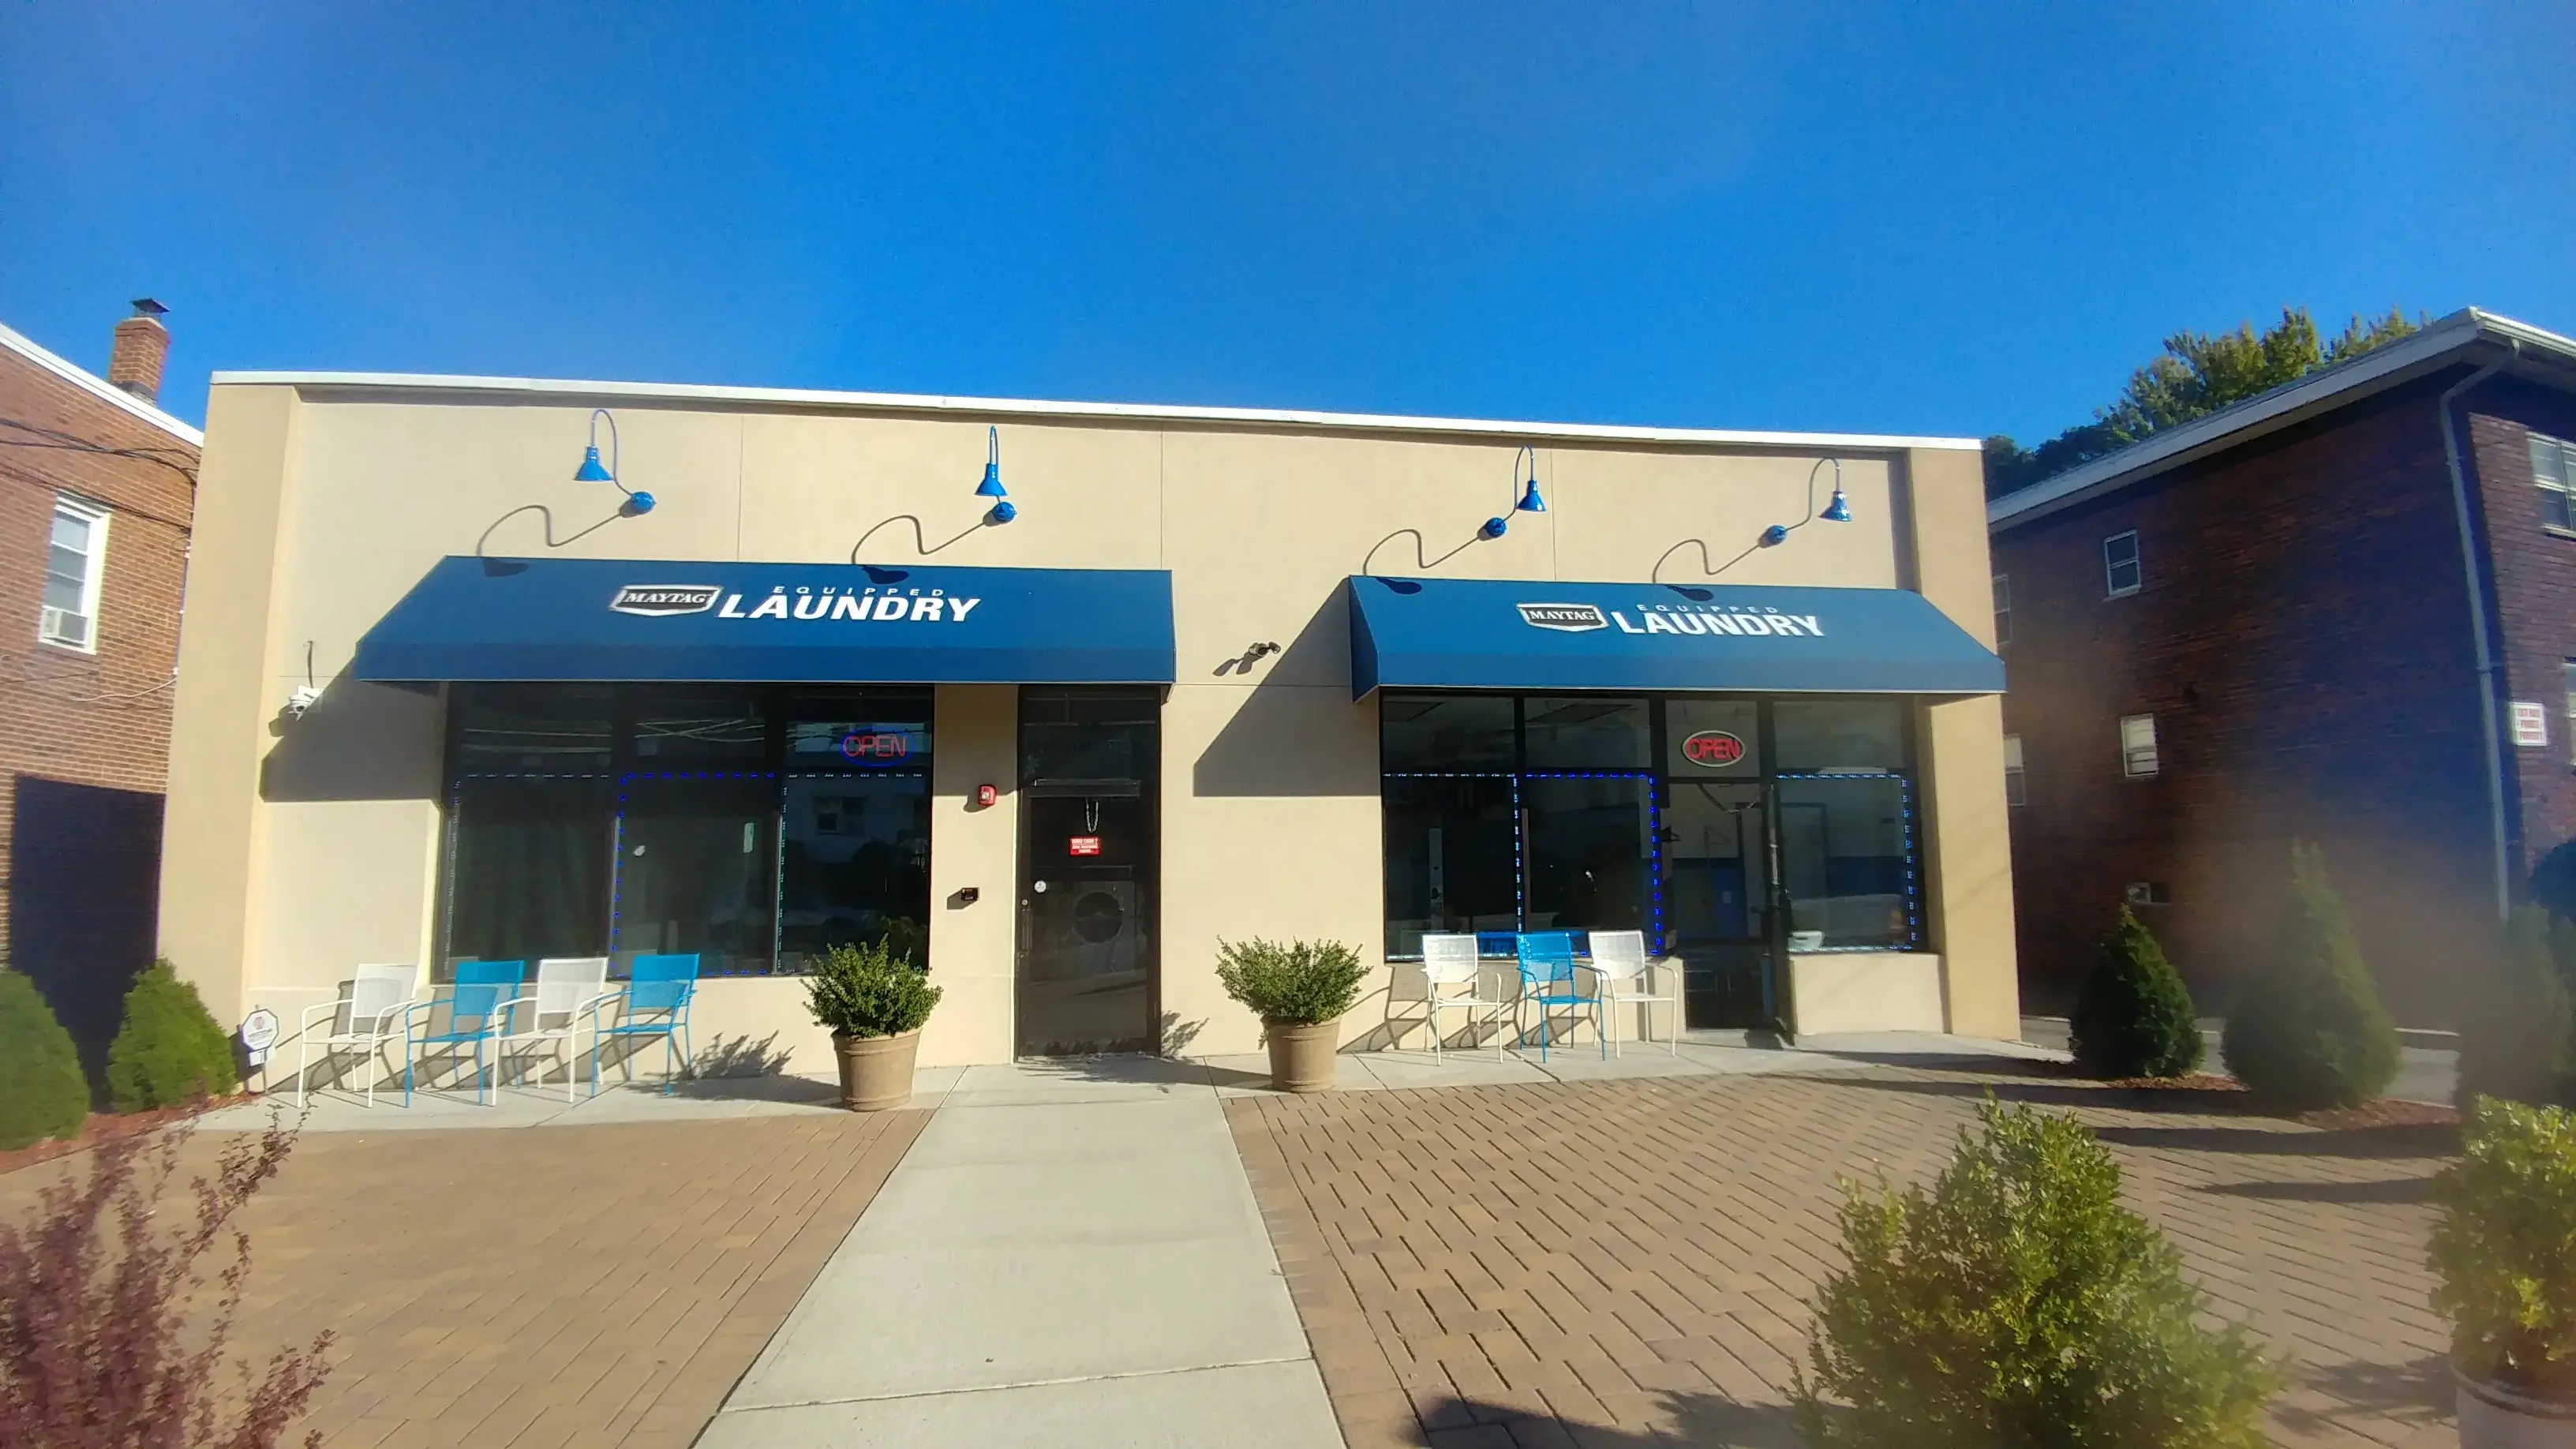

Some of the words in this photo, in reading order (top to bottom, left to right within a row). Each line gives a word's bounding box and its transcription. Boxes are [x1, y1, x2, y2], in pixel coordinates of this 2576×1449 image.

[623, 593, 711, 604] MAYTAG
[773, 586, 944, 597] EQUIPPED
[717, 593, 981, 622] LAUNDRY
[1528, 610, 1595, 620] MAYTAG
[1636, 604, 1779, 613] EQUIPPED
[1610, 612, 1825, 637] LAUNDRY
[842, 735, 907, 758] OPEN
[1686, 737, 1741, 759] OPEN
